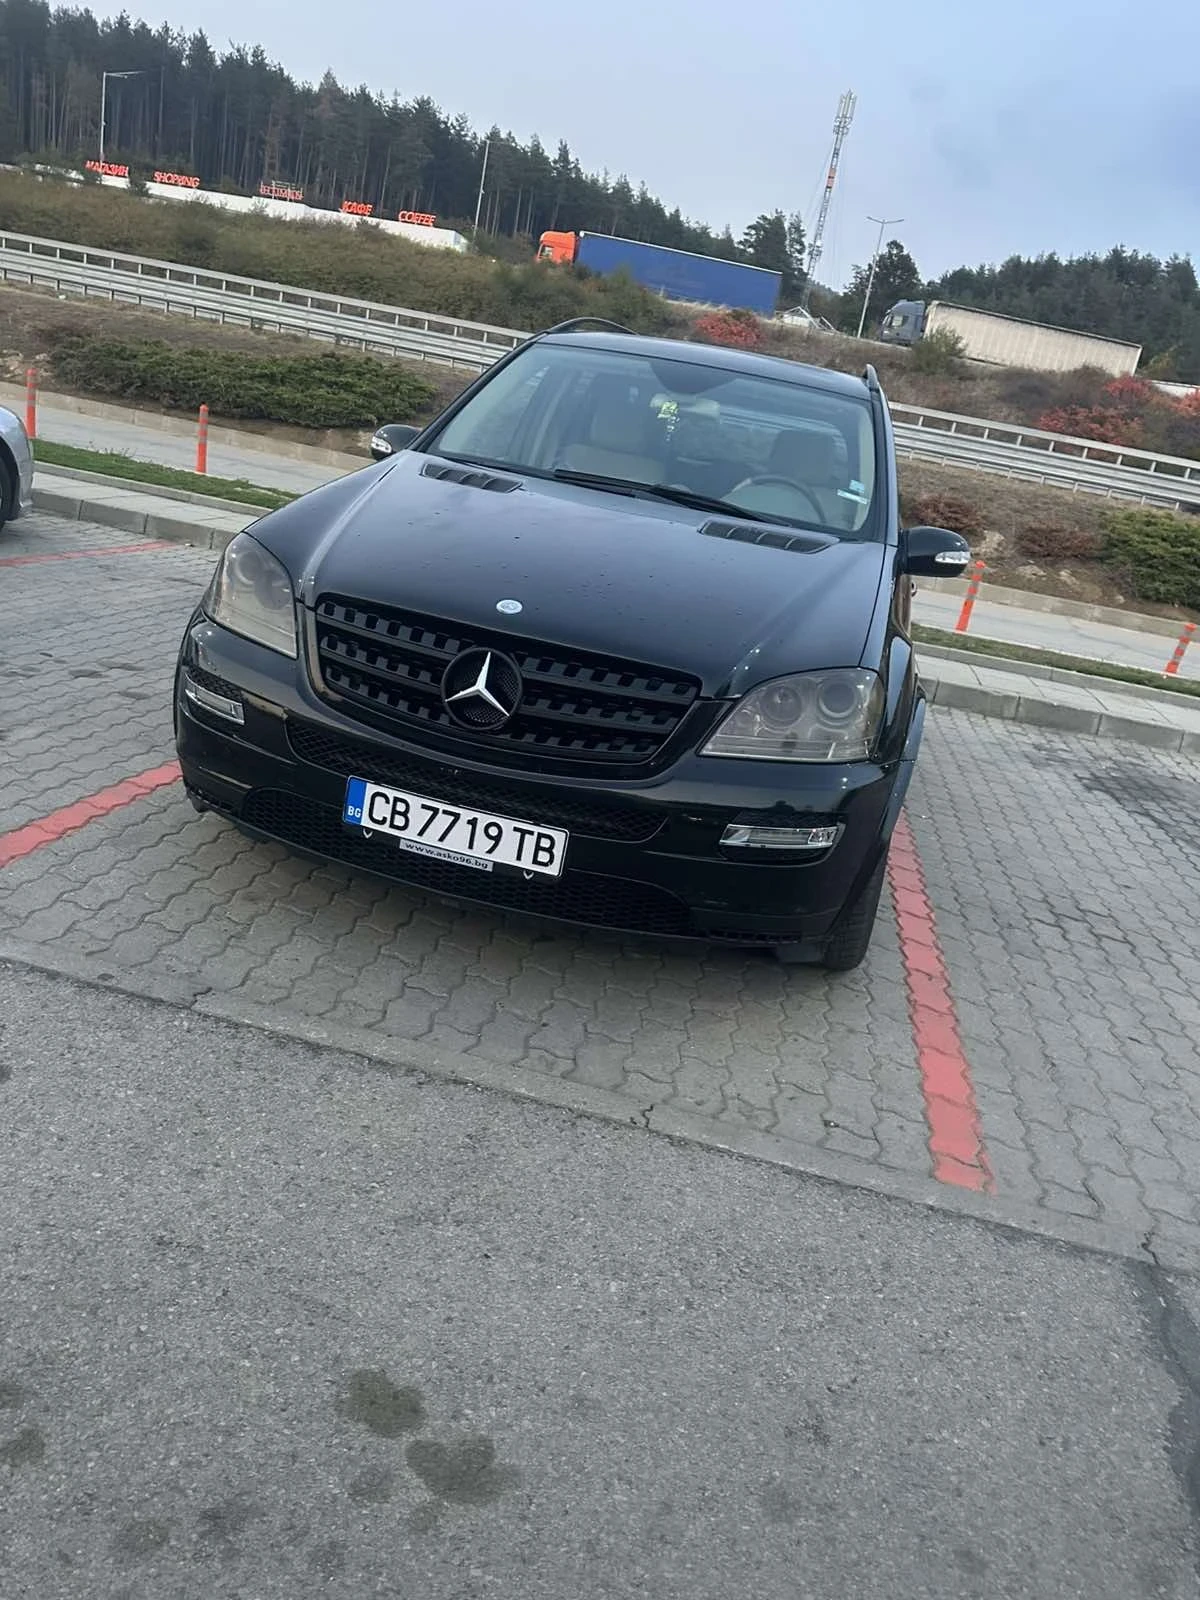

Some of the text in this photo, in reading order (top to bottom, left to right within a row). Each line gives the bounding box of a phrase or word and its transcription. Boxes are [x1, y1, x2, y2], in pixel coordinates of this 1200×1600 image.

[153, 171, 200, 188] SHOPPING
[398, 210, 436, 226] COFFEE
[348, 805, 361, 819] BG
[405, 842, 488, 870] www.asko96.bg
